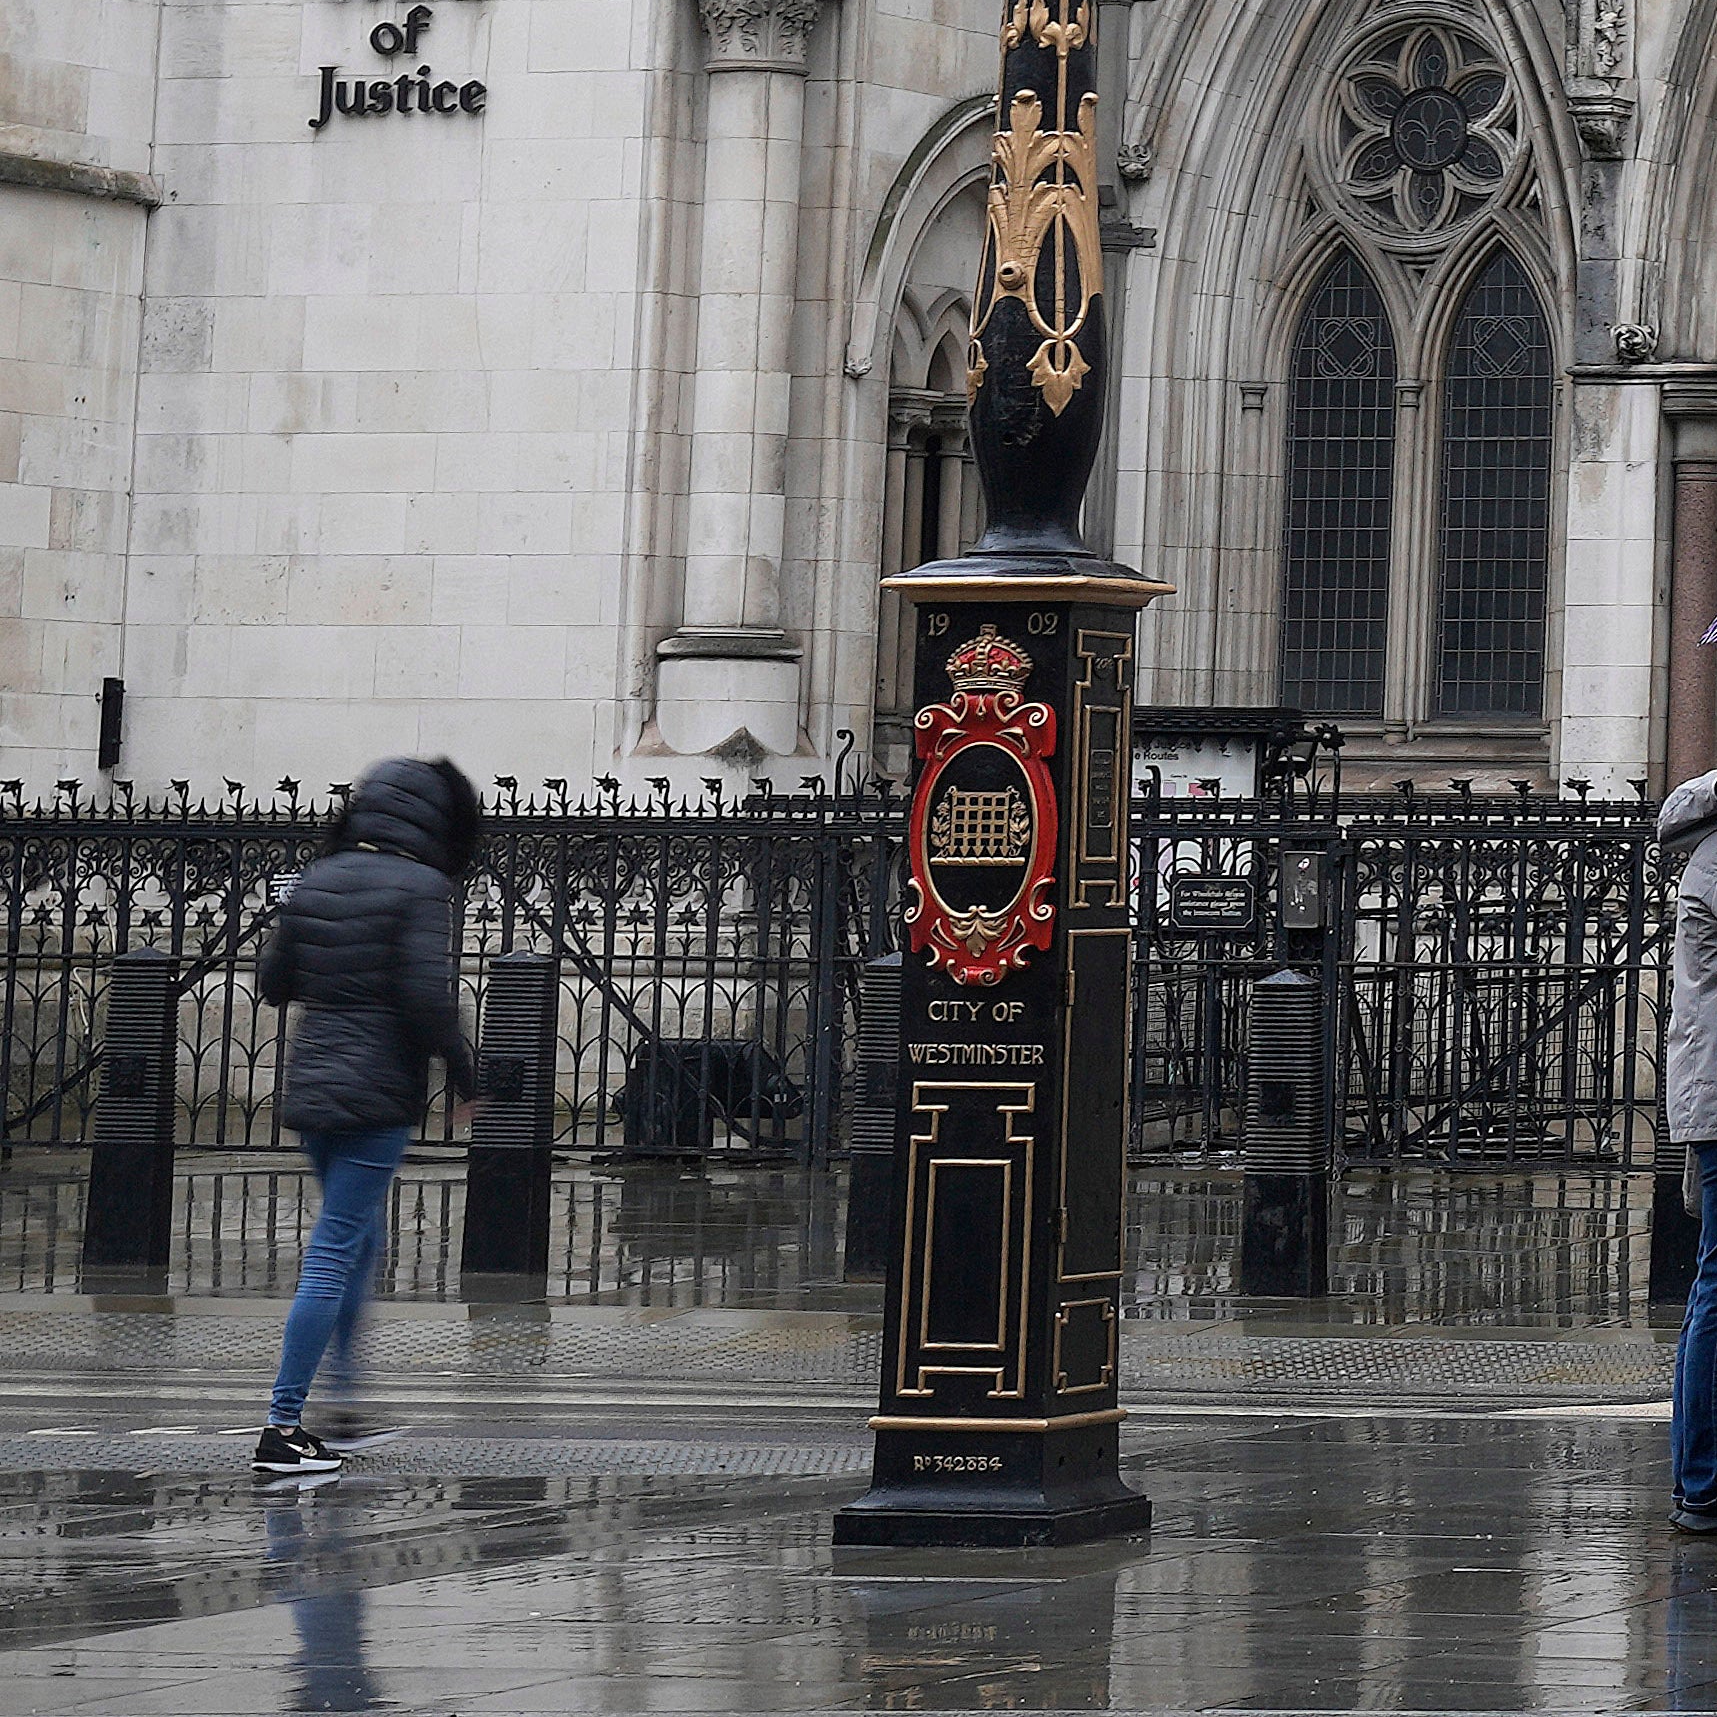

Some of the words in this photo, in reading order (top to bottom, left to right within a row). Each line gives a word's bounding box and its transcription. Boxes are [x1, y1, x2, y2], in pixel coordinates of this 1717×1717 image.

[369, 4, 433, 57] of
[308, 64, 488, 130] Justice
[927, 613, 949, 636] 19
[1027, 612, 1060, 636] 02
[927, 1000, 985, 1022] CITY
[992, 1001, 1025, 1022] OF
[907, 1043, 1044, 1065] WESTMINSTER
